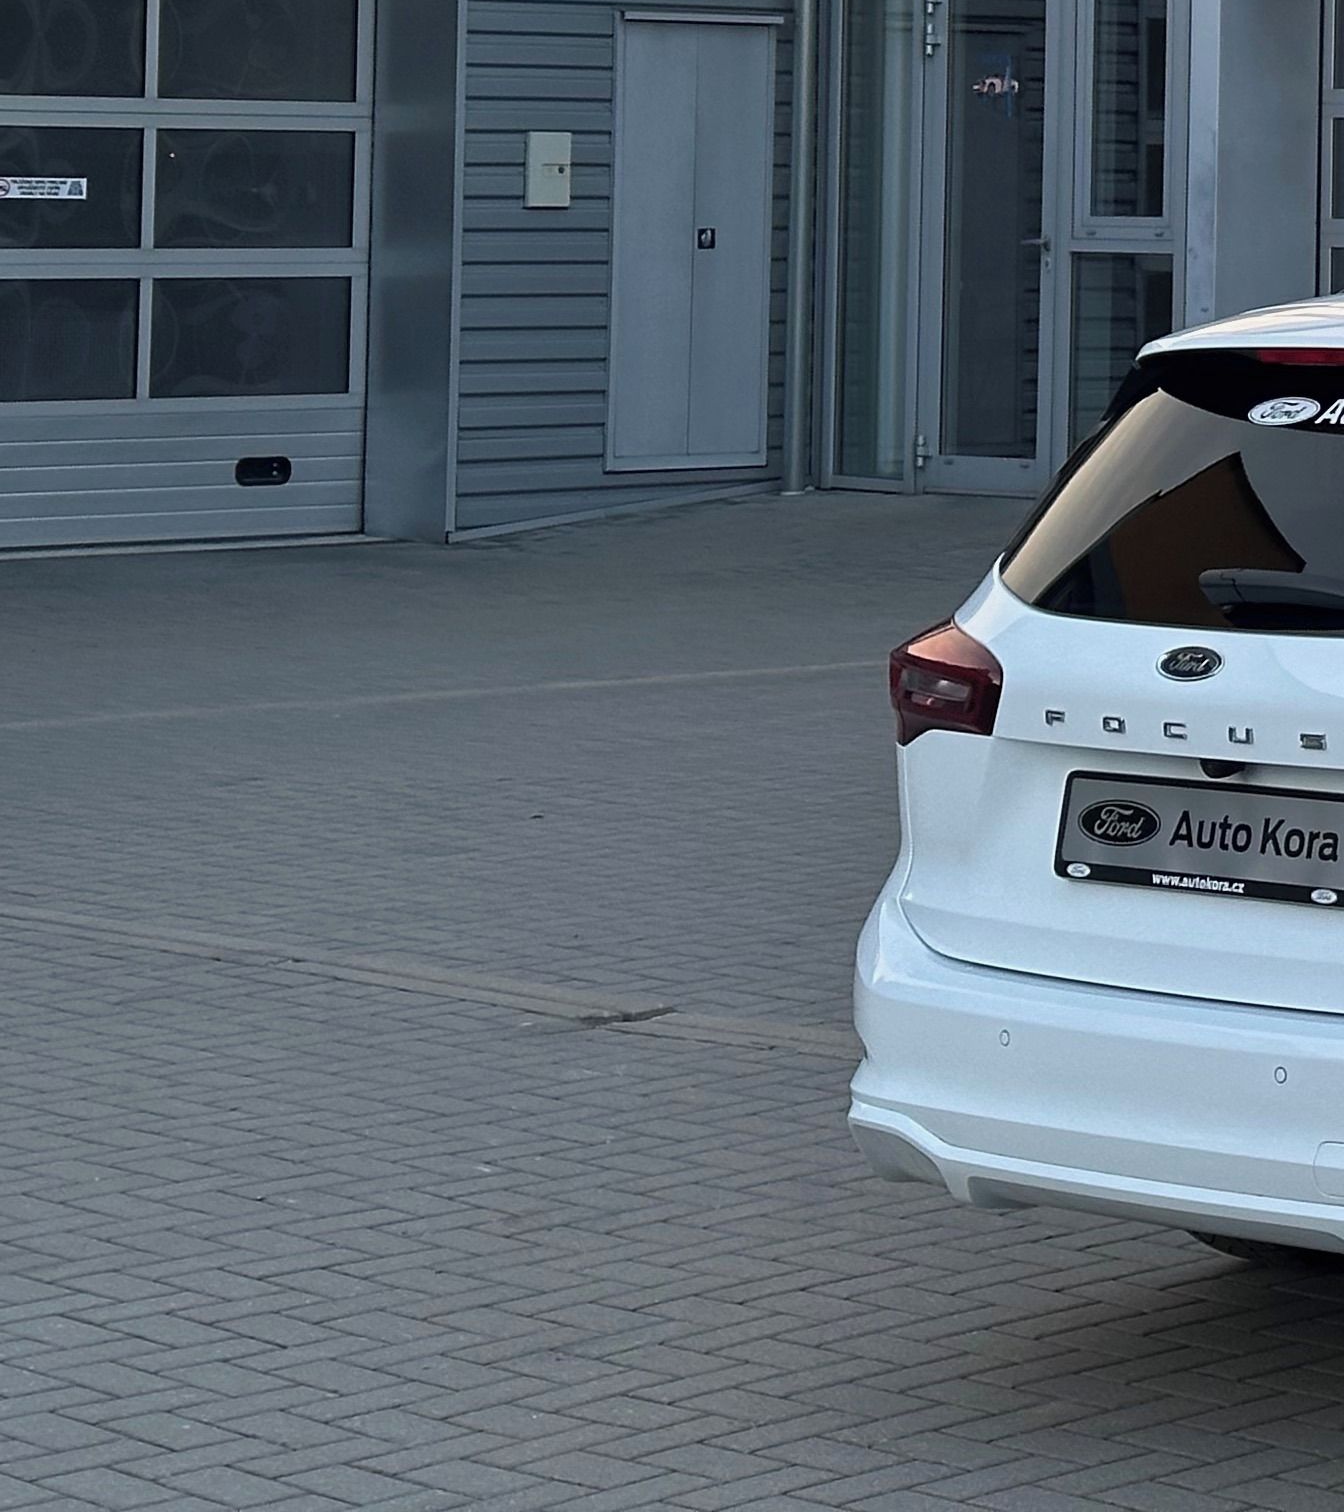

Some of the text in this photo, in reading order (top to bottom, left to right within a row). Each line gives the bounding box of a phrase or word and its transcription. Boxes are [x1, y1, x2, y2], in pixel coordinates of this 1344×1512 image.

[1044, 709, 1328, 751] FOCUS
[1169, 810, 1252, 853] Auto
[1260, 817, 1340, 862] Kora
[1152, 873, 1245, 894] www.autokora.cz
